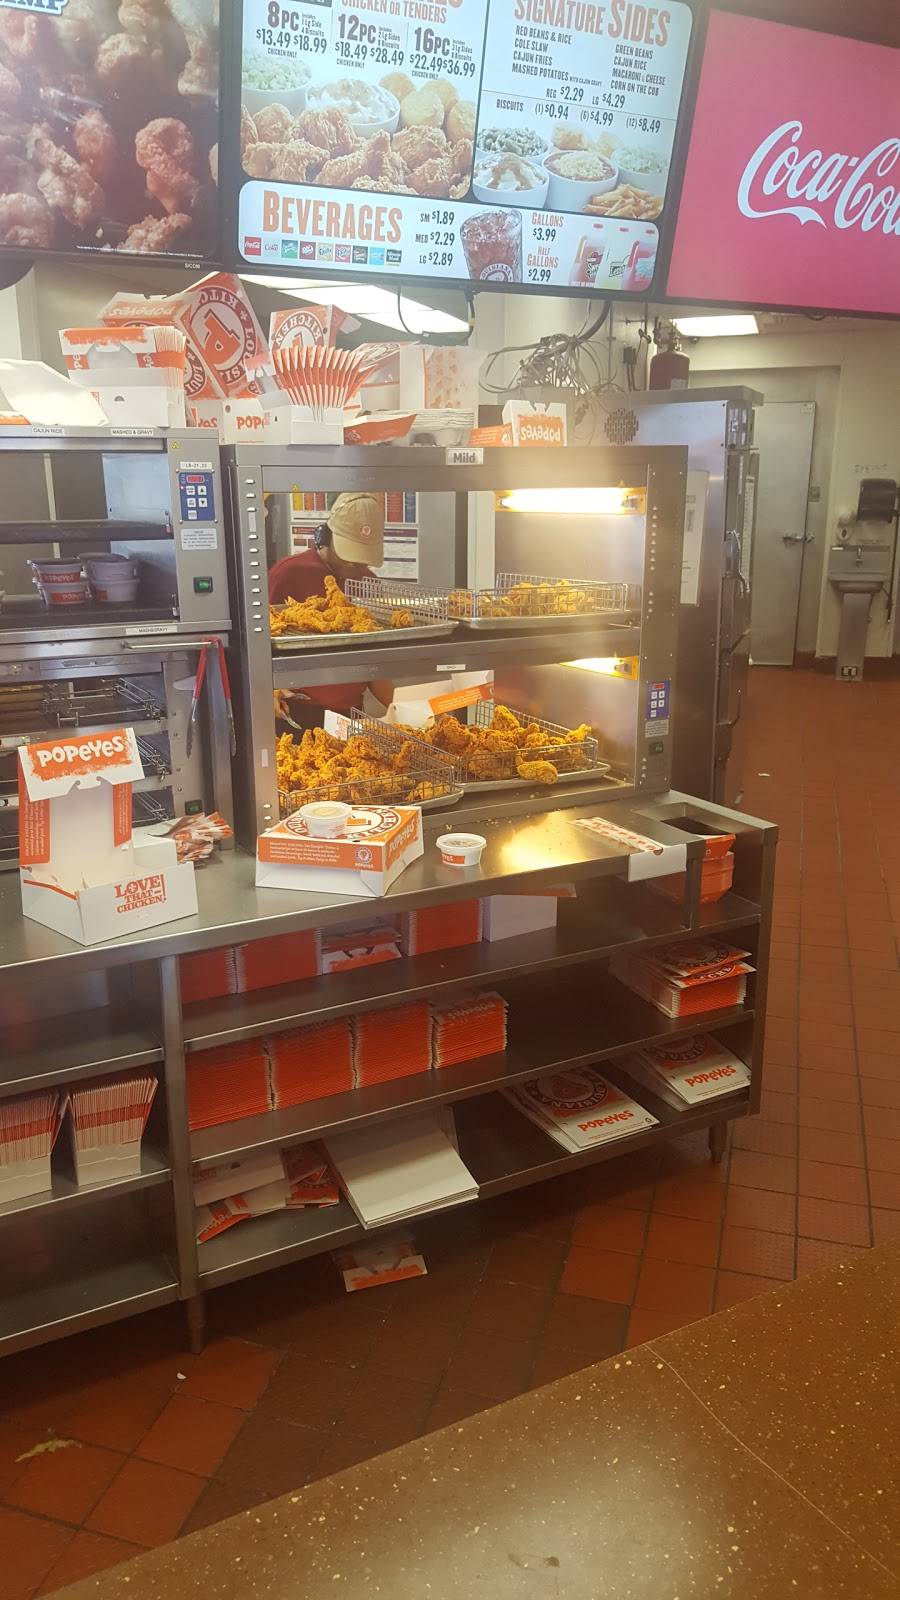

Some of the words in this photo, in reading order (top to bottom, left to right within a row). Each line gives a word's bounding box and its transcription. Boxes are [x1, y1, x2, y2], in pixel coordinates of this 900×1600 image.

[267, 1, 300, 31] 8PC
[389, 2, 400, 16] OR
[403, 1, 447, 24] TENDERS
[338, 13, 377, 44] 12PC
[514, 0, 606, 36] SIGNATURE
[607, 0, 671, 47] SIDES
[256, 28, 291, 48] $13.49
[293, 34, 327, 54] $18.99
[415, 27, 451, 56] 16PC
[515, 25, 528, 37] RED
[529, 27, 549, 41] BEANS
[550, 31, 556, 42] &
[558, 32, 573, 45] RICE
[335, 41, 368, 61] $18.49
[370, 47, 404, 66] $28.49
[514, 38, 531, 50] COLE
[531, 41, 549, 53] SLAW
[615, 44, 633, 56] GREEN
[634, 47, 654, 60] BEANS
[410, 54, 442, 72] $22.49
[442, 59, 475, 77] $36.99
[513, 51, 534, 64] CAJUN
[535, 54, 553, 67] FRIES
[613, 58, 633, 69] CAJUN
[634, 60, 648, 71] RICE
[512, 63, 538, 77] MASHED
[539, 67, 569, 82] POTATOES
[612, 68, 641, 82] MACARONI
[645, 74, 666, 86] CHEESE
[546, 88, 557, 99] REG
[559, 86, 584, 102] $2.29
[602, 93, 626, 109] $4.29
[610, 80, 626, 91] CORN
[627, 83, 635, 92] ON
[636, 84, 647, 94] THE
[647, 85, 659, 96] COB
[496, 98, 524, 112] BISCUITS
[544, 103, 569, 120] $0.94
[590, 110, 614, 126] $4.99
[638, 118, 661, 134] $8.49
[738, 120, 900, 237] Coca-Co
[262, 190, 402, 244] BEVERAGES
[420, 212, 430, 223] SM
[432, 210, 455, 226] $1.89
[531, 211, 564, 228] GALLONS
[415, 233, 429, 244] MED
[430, 231, 455, 246] $2.29
[532, 227, 557, 242] $3.99
[419, 254, 427, 264] LG
[428, 252, 453, 266] $2.89
[527, 254, 559, 268] GALLONS
[528, 267, 551, 283] $2.99
[276, 314, 321, 345] KITCHEN
[453, 452, 476, 464] Mild
[114, 875, 160, 898] LOVE
